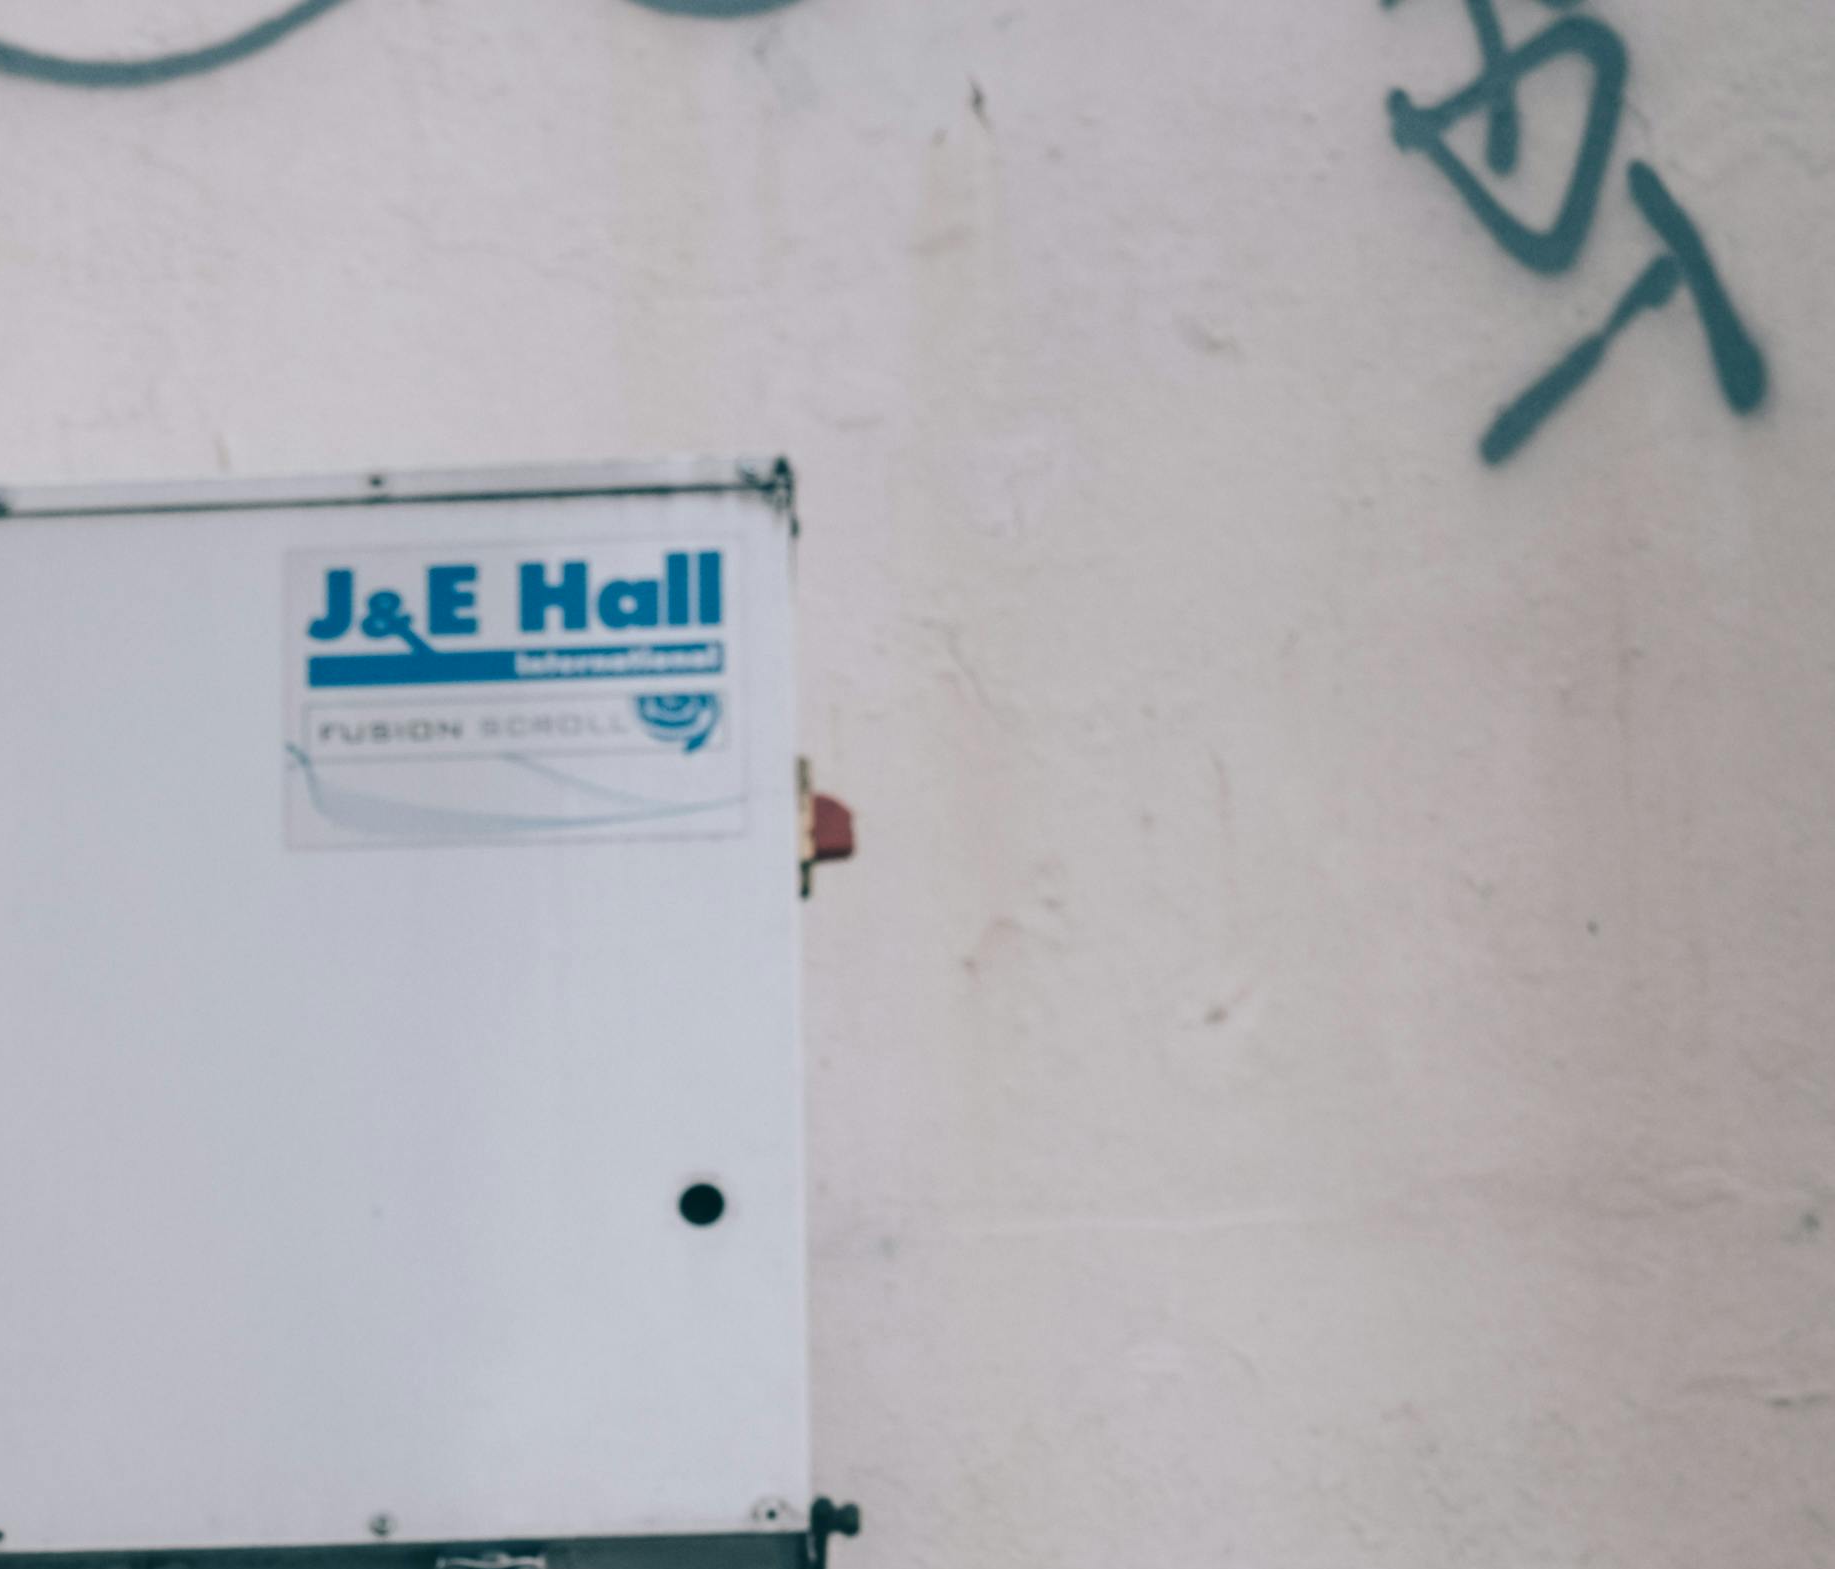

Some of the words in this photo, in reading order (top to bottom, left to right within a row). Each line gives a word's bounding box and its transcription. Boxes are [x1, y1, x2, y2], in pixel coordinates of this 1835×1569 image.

[307, 564, 479, 648] J&E
[518, 550, 722, 632] Hall
[318, 718, 464, 745] FUSION
[480, 711, 630, 738] SCROLL
